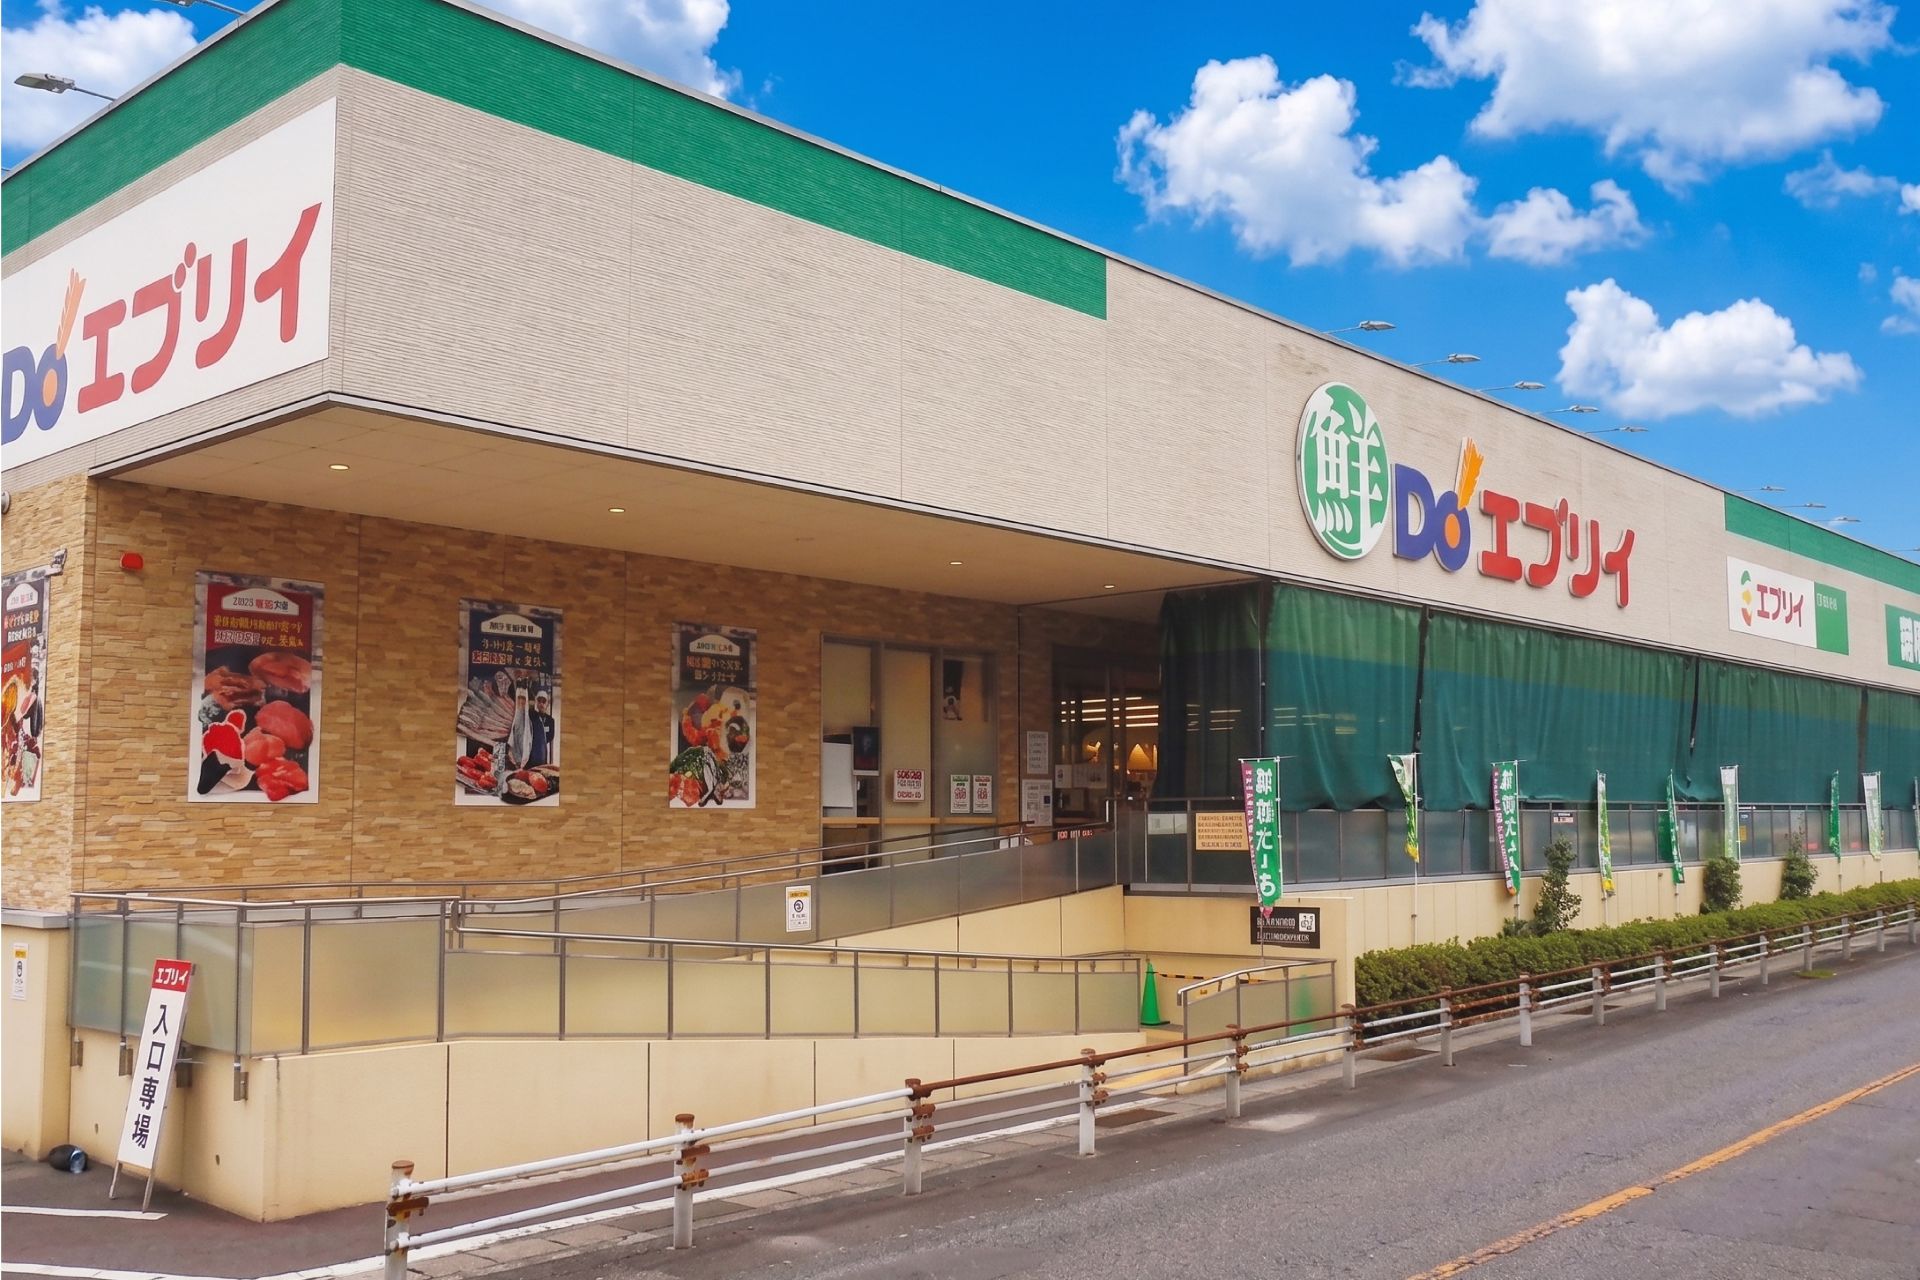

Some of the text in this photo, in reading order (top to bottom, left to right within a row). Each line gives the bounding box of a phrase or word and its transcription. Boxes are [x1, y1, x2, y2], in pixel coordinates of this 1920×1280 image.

[77, 202, 322, 414] エブリイ
[1479, 489, 1635, 608] エブリイ
[1757, 584, 1804, 628] エブリイ
[155, 967, 188, 986] エブリイ
